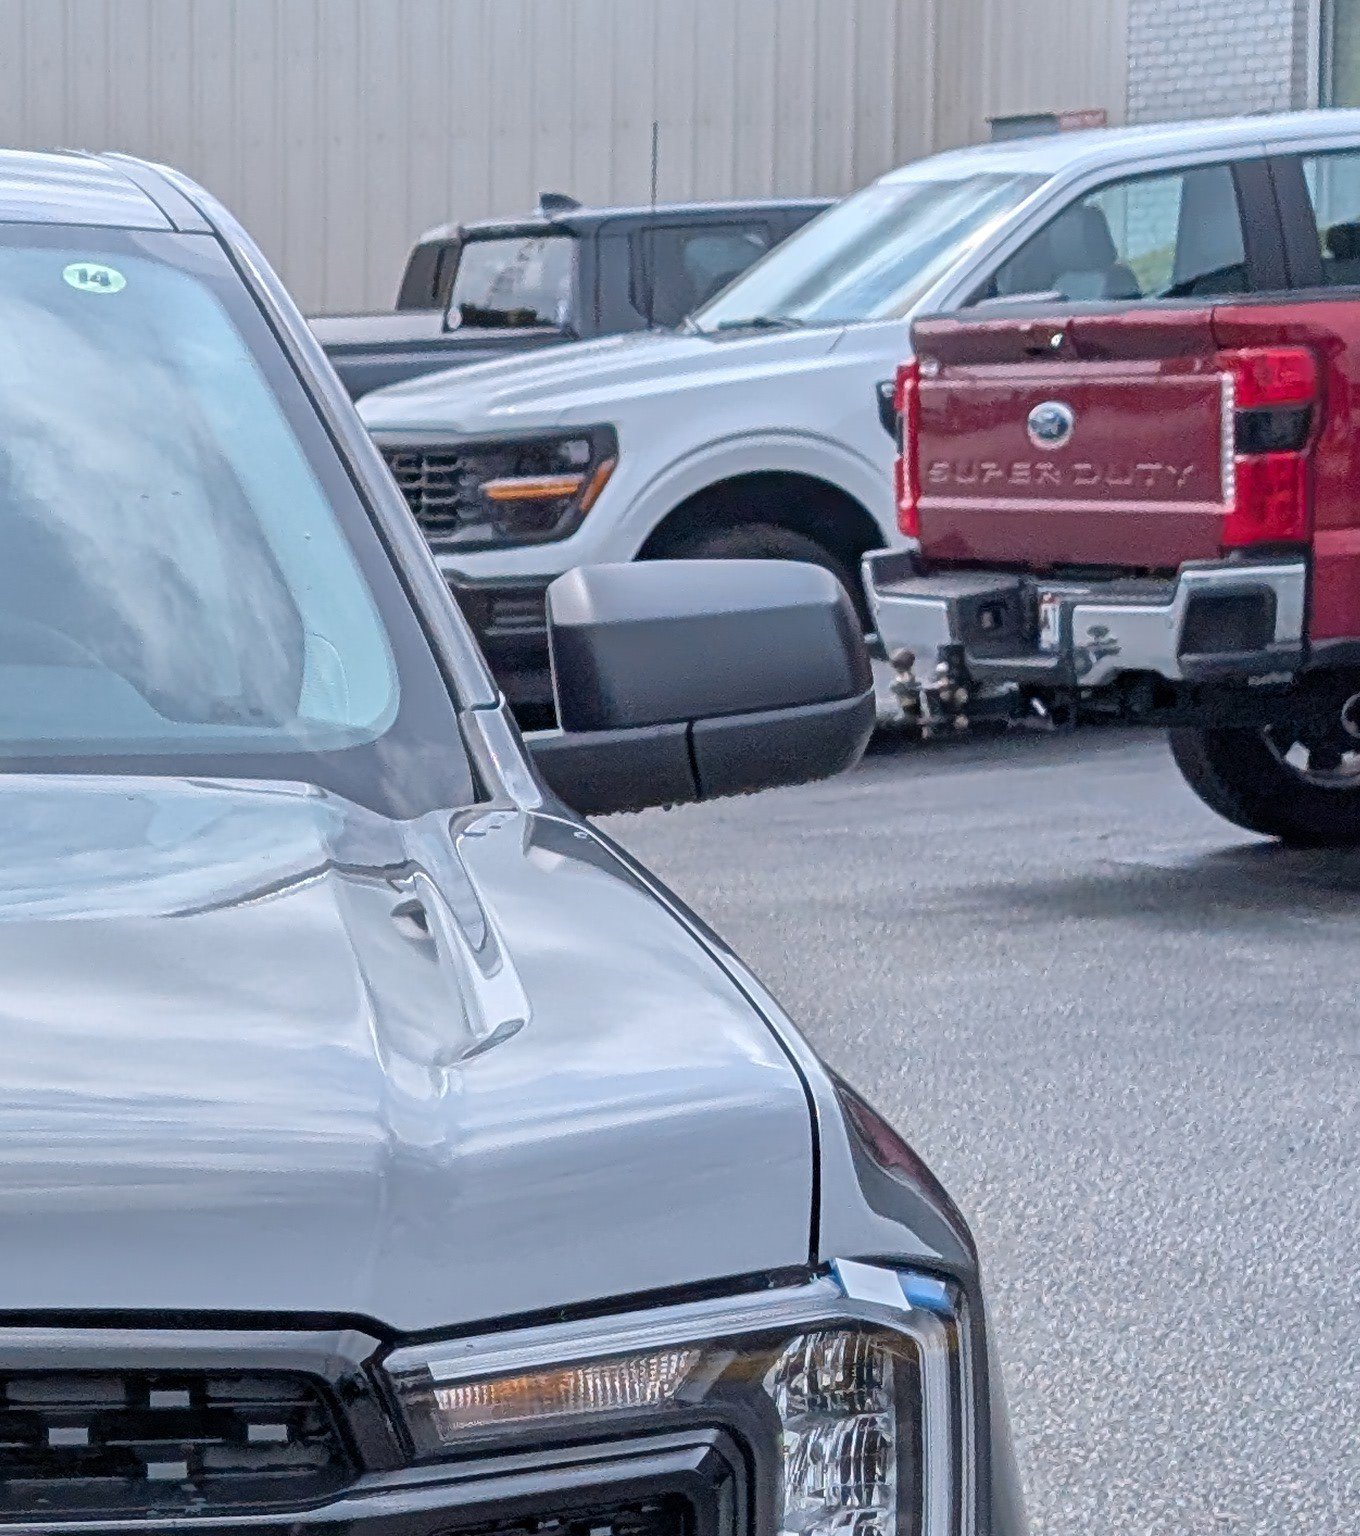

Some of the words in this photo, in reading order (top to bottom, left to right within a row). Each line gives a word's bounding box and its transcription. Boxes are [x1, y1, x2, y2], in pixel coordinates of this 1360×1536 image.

[78, 267, 111, 287] 14
[928, 461, 1063, 486] SUPER
[1073, 461, 1196, 487] DUTY
